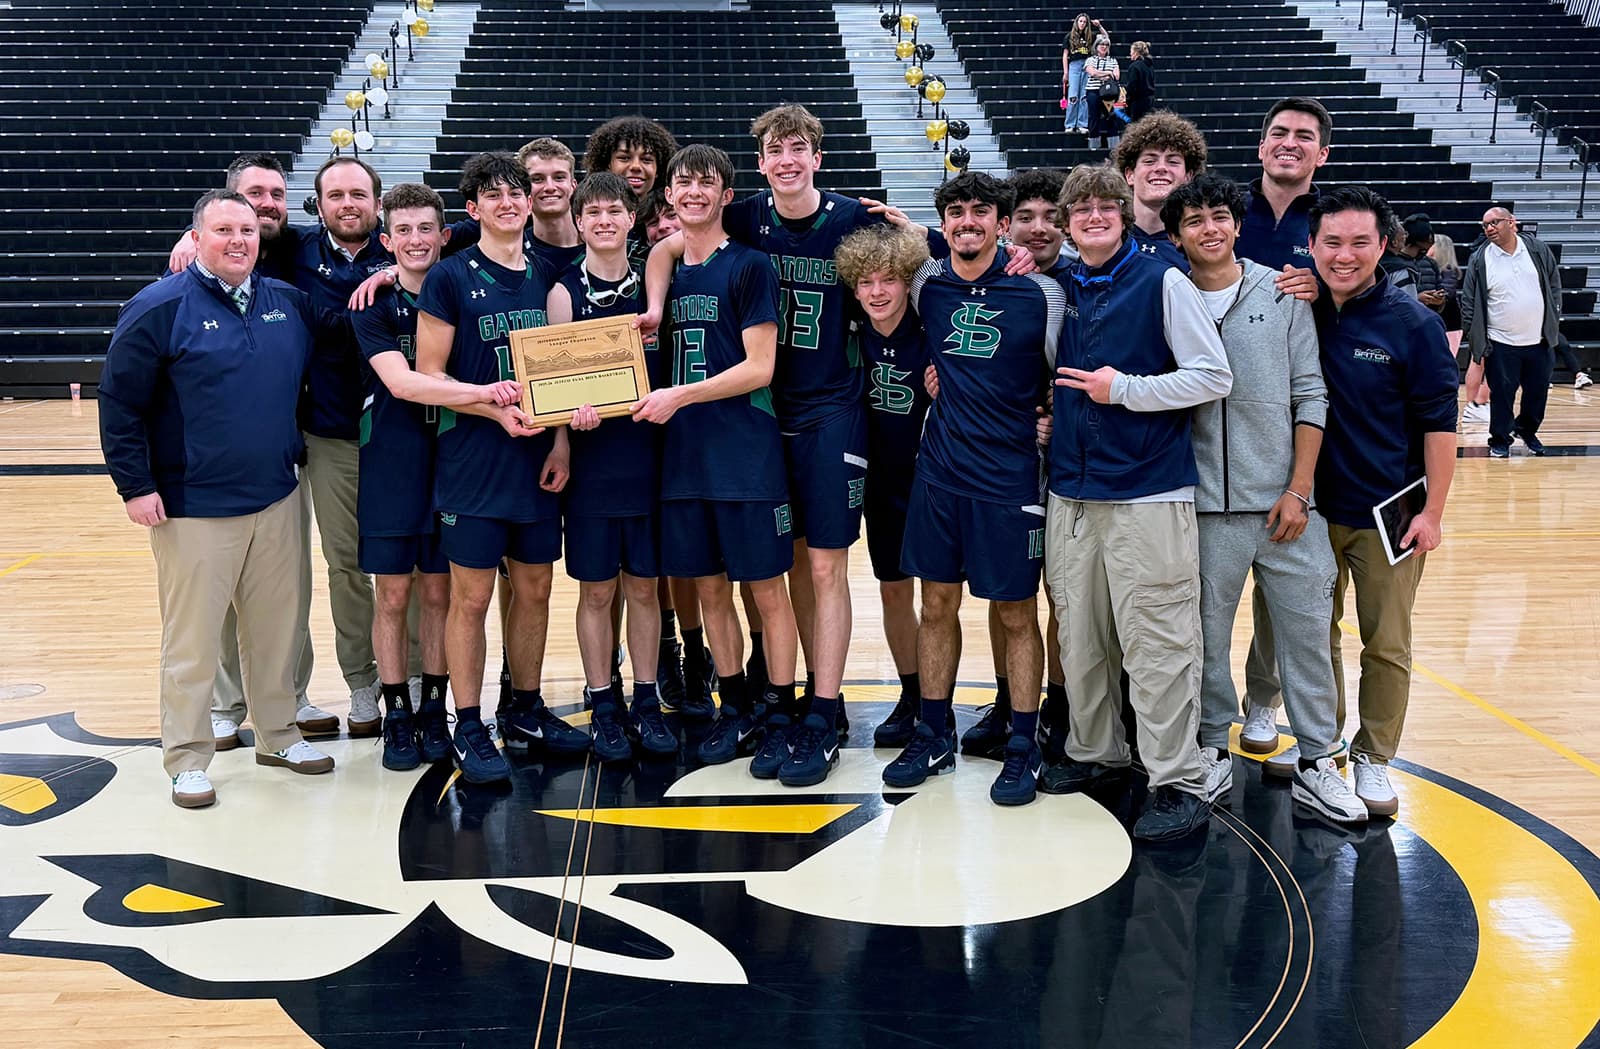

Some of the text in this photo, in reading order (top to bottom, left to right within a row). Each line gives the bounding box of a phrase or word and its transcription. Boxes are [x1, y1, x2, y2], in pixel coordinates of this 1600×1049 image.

[478, 308, 548, 342] GATOR
[671, 294, 719, 323] ATORS
[671, 328, 707, 387] 12
[848, 477, 865, 509] 33
[773, 503, 791, 536] 12
